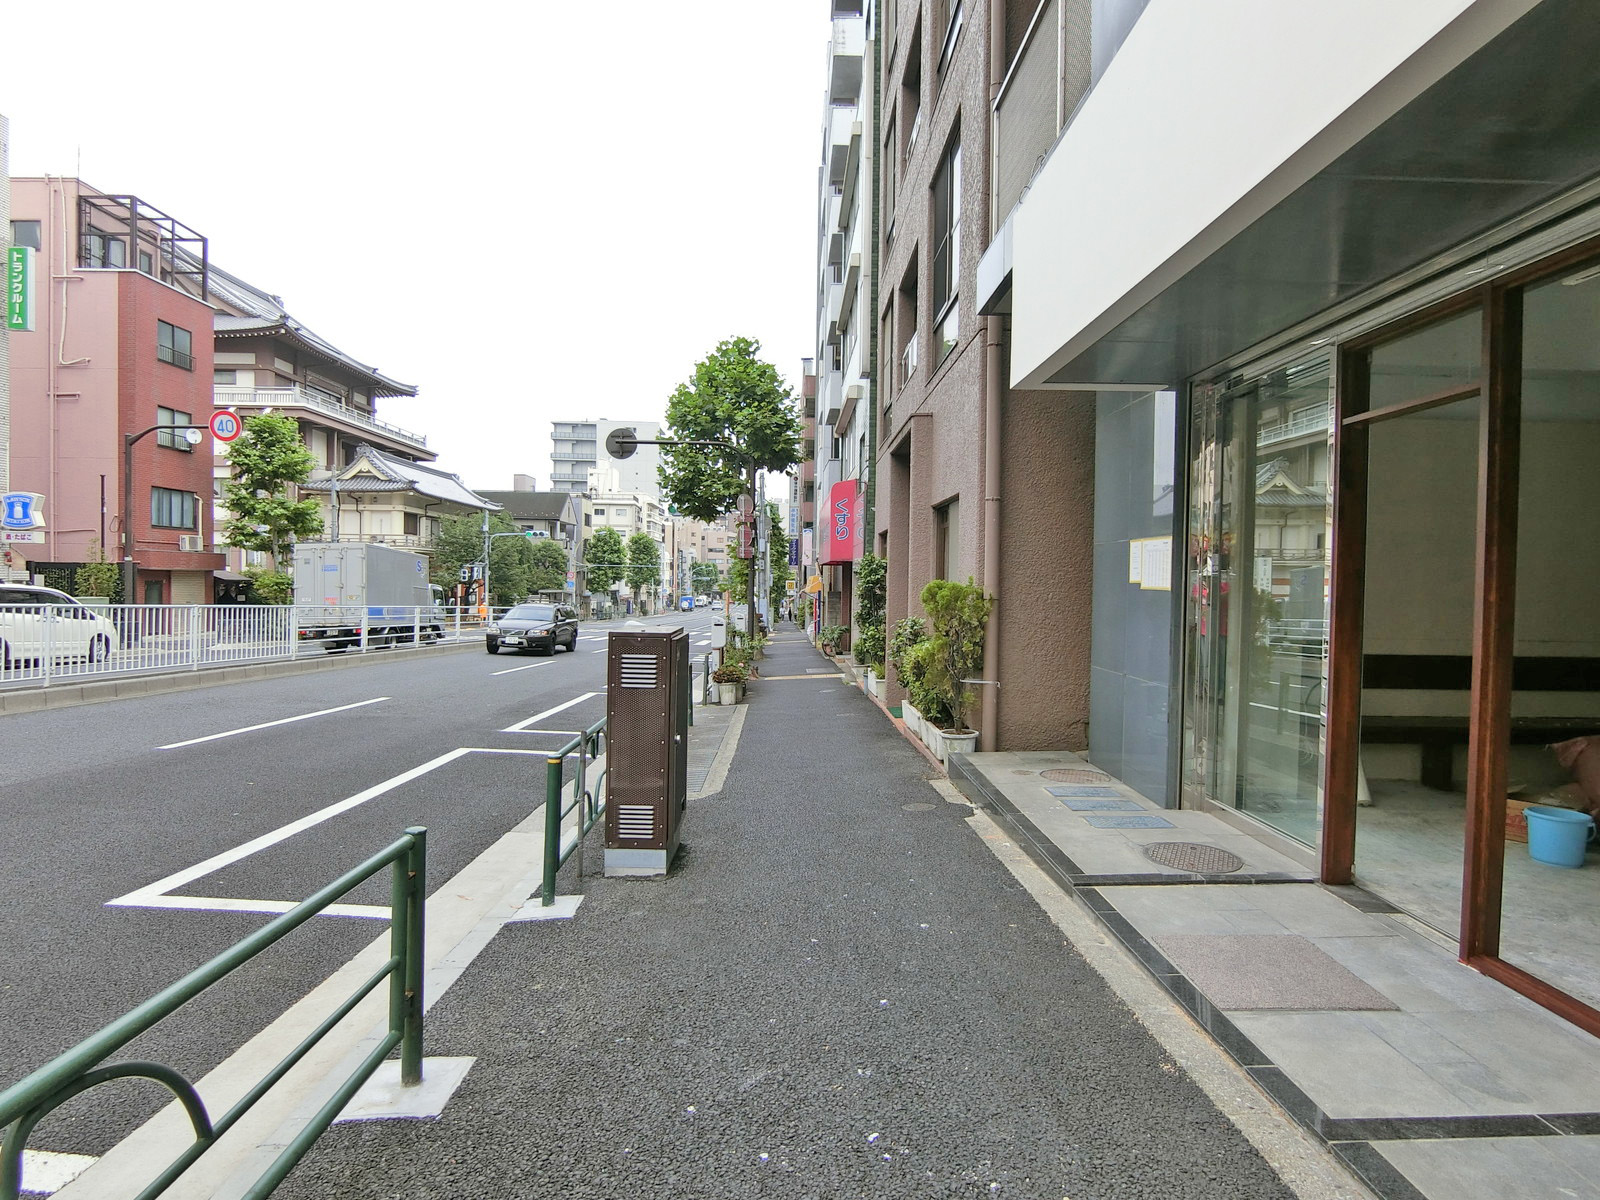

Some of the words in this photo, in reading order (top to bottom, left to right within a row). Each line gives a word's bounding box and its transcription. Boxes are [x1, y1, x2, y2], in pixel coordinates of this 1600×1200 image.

[12, 251, 23, 324] トランクルーム
[217, 419, 234, 433] 40
[835, 498, 850, 541] くすり
